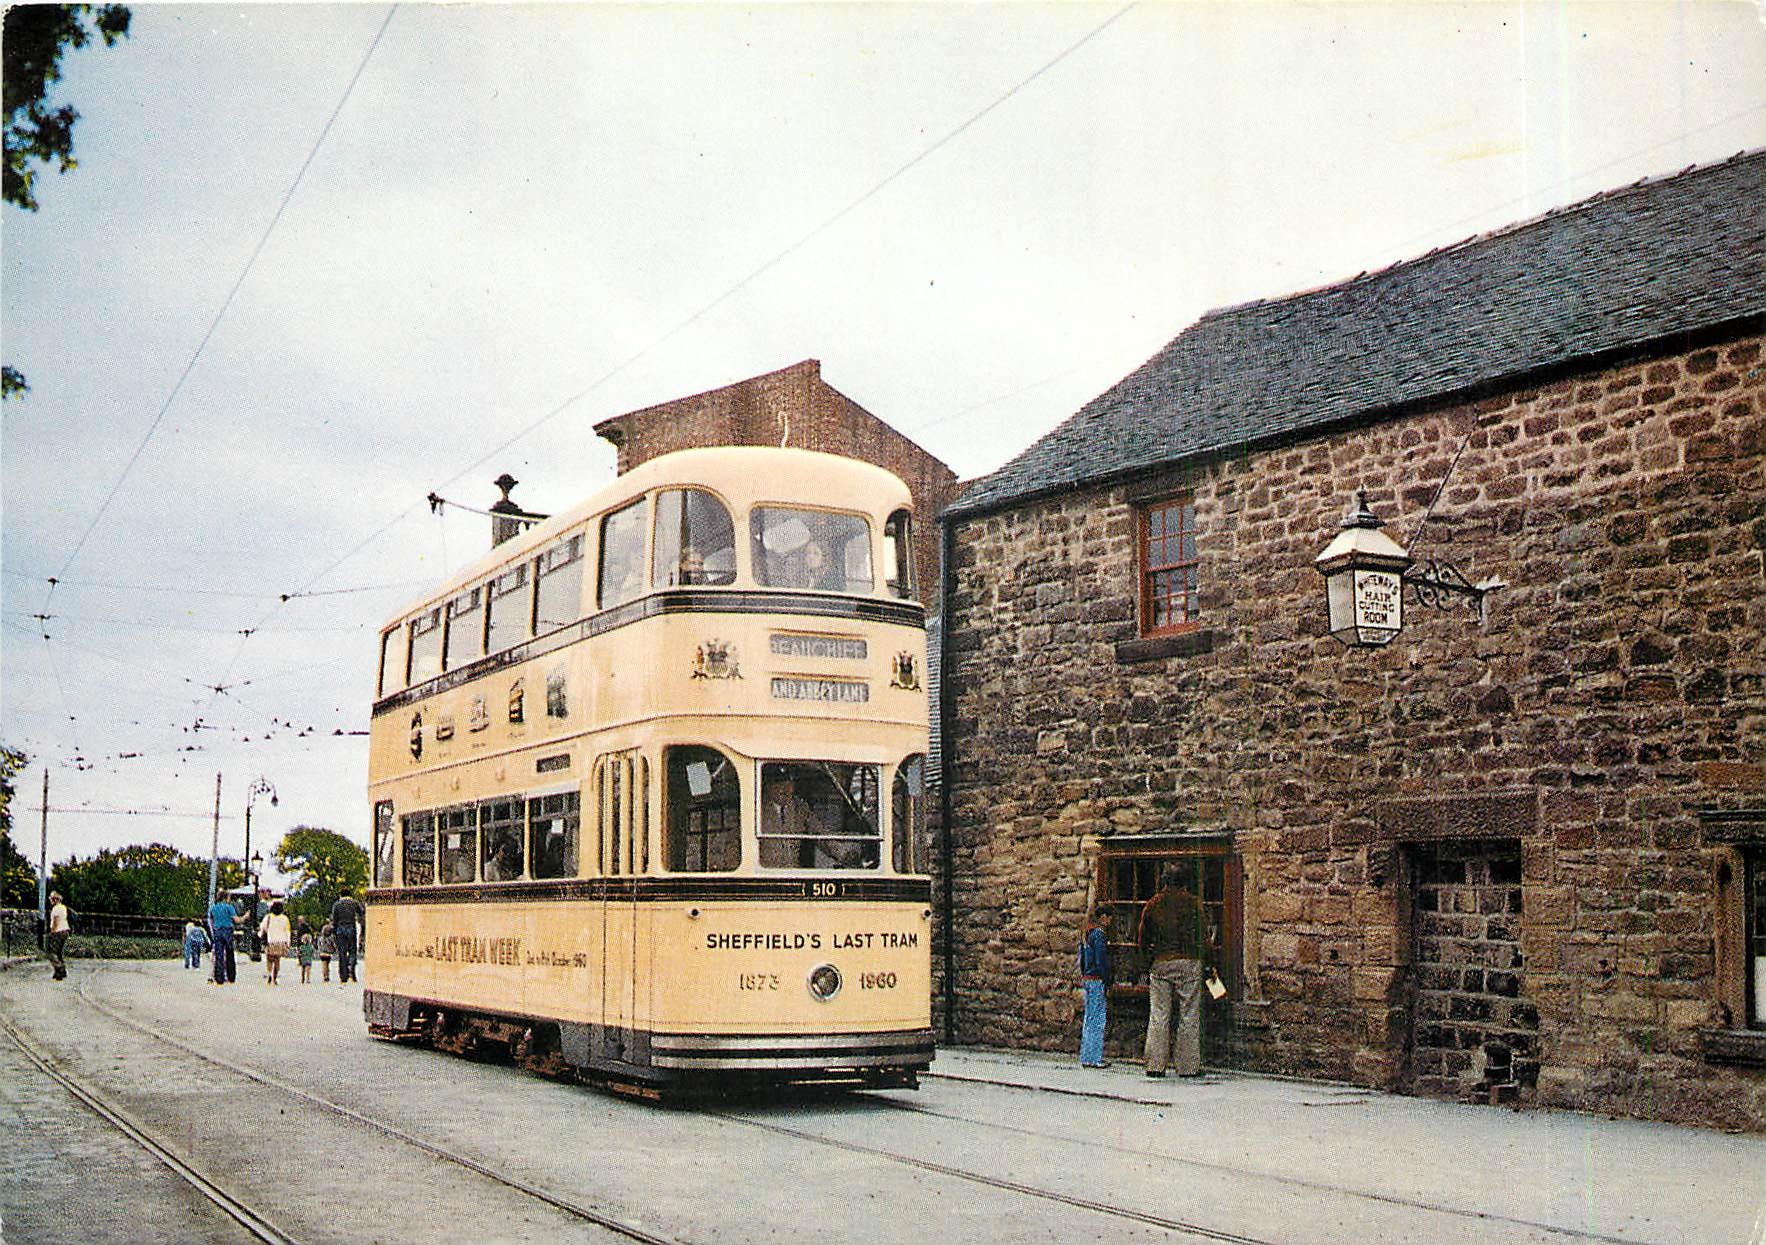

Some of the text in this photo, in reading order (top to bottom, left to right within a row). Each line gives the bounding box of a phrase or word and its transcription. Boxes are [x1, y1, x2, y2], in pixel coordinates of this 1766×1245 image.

[1365, 591, 1391, 602] HAIR
[1359, 600, 1394, 613] CUTTING
[1363, 611, 1388, 624] ROOM
[812, 883, 836, 896] 510
[706, 933, 918, 949] SHEFFIELD'S LAST TRAM
[436, 936, 457, 962] LAST
[460, 936, 487, 963] TRAM
[490, 937, 521, 965] WEEK
[859, 972, 897, 990] 1960
